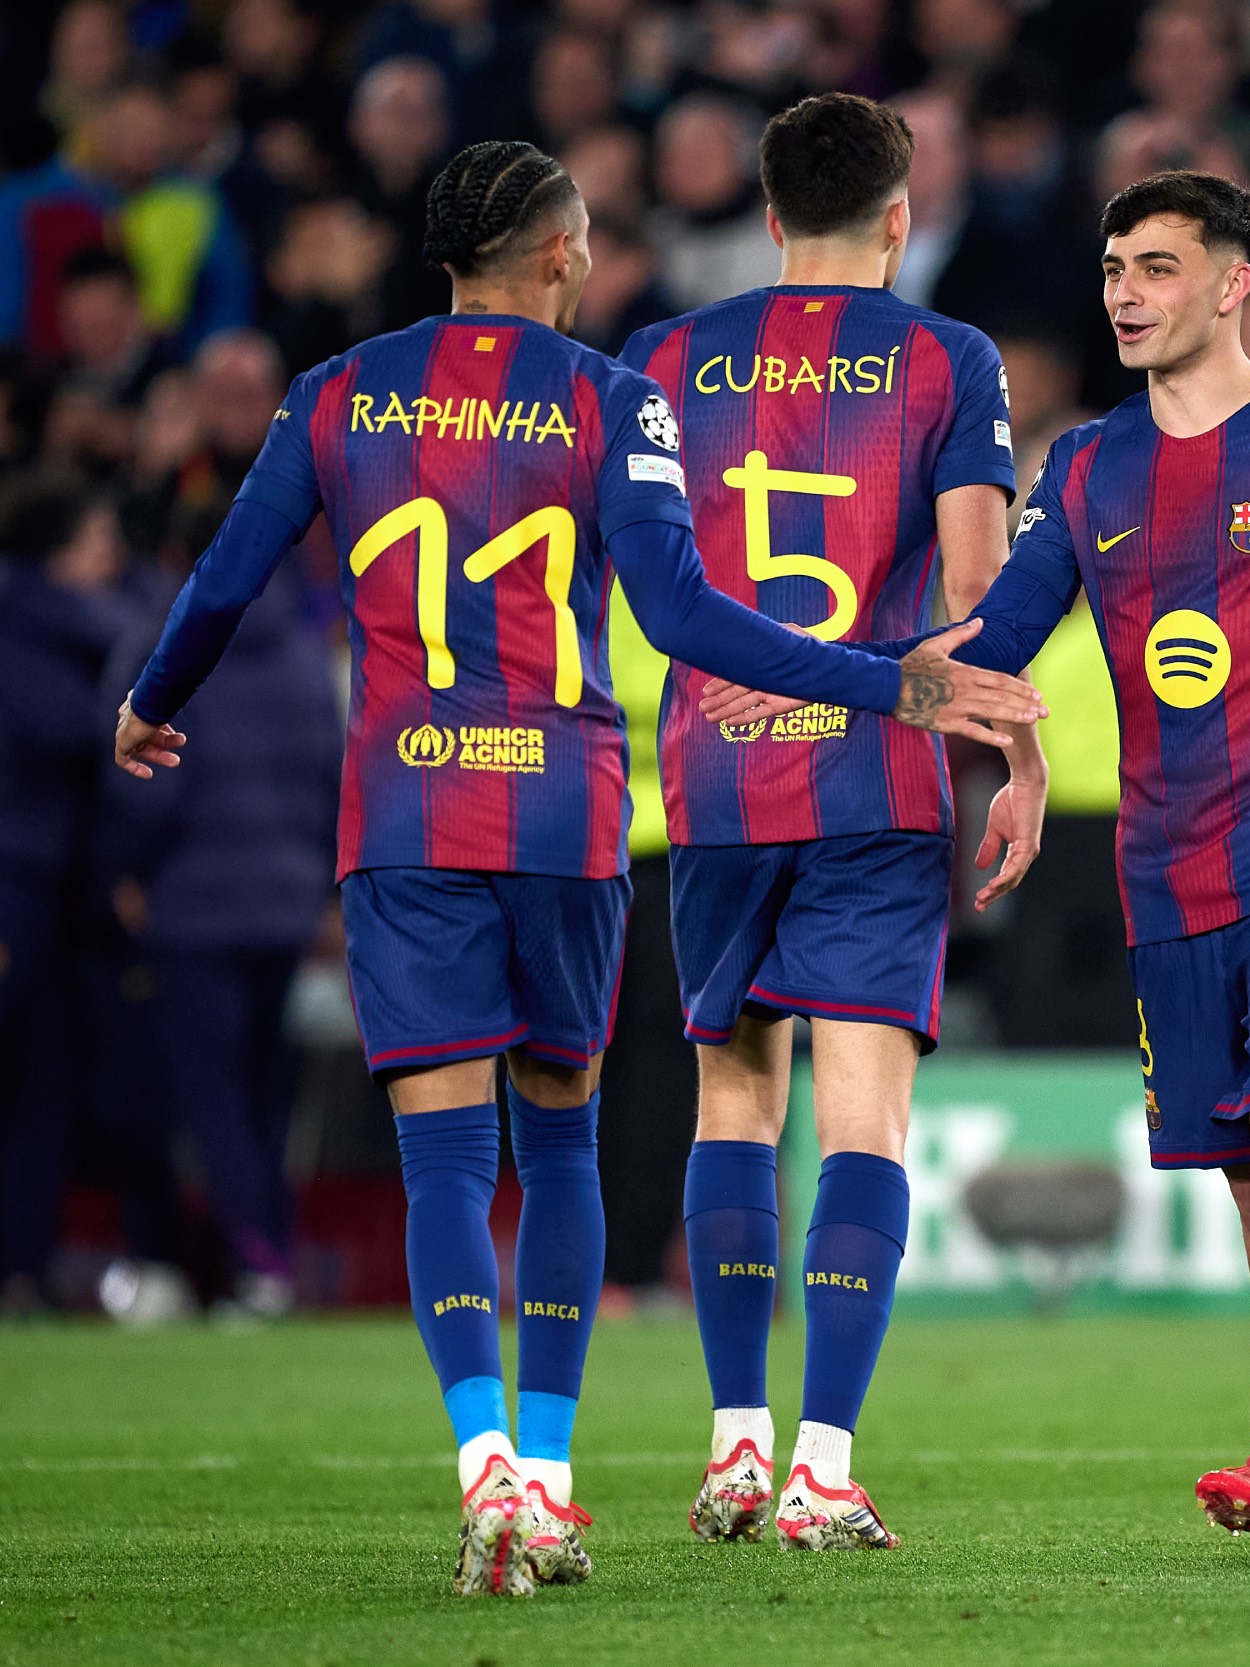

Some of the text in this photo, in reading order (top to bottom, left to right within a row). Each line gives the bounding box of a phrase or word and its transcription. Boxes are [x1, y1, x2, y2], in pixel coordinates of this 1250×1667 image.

[695, 345, 900, 394] CUBARSÍ
[351, 391, 577, 448] RAPHINHA
[722, 449, 859, 643] 5
[348, 496, 584, 709] 11
[775, 702, 848, 717] NHCR
[770, 715, 847, 735] ACNUR
[822, 731, 846, 739] Agency
[459, 726, 545, 747] UNHCR
[458, 744, 545, 765] ACNUR
[459, 762, 473, 770] The
[719, 1262, 776, 1279] BARÇA
[806, 1271, 869, 1292] BARÇA
[433, 1294, 492, 1316] BARÇA
[523, 1301, 580, 1321] BARÇA
